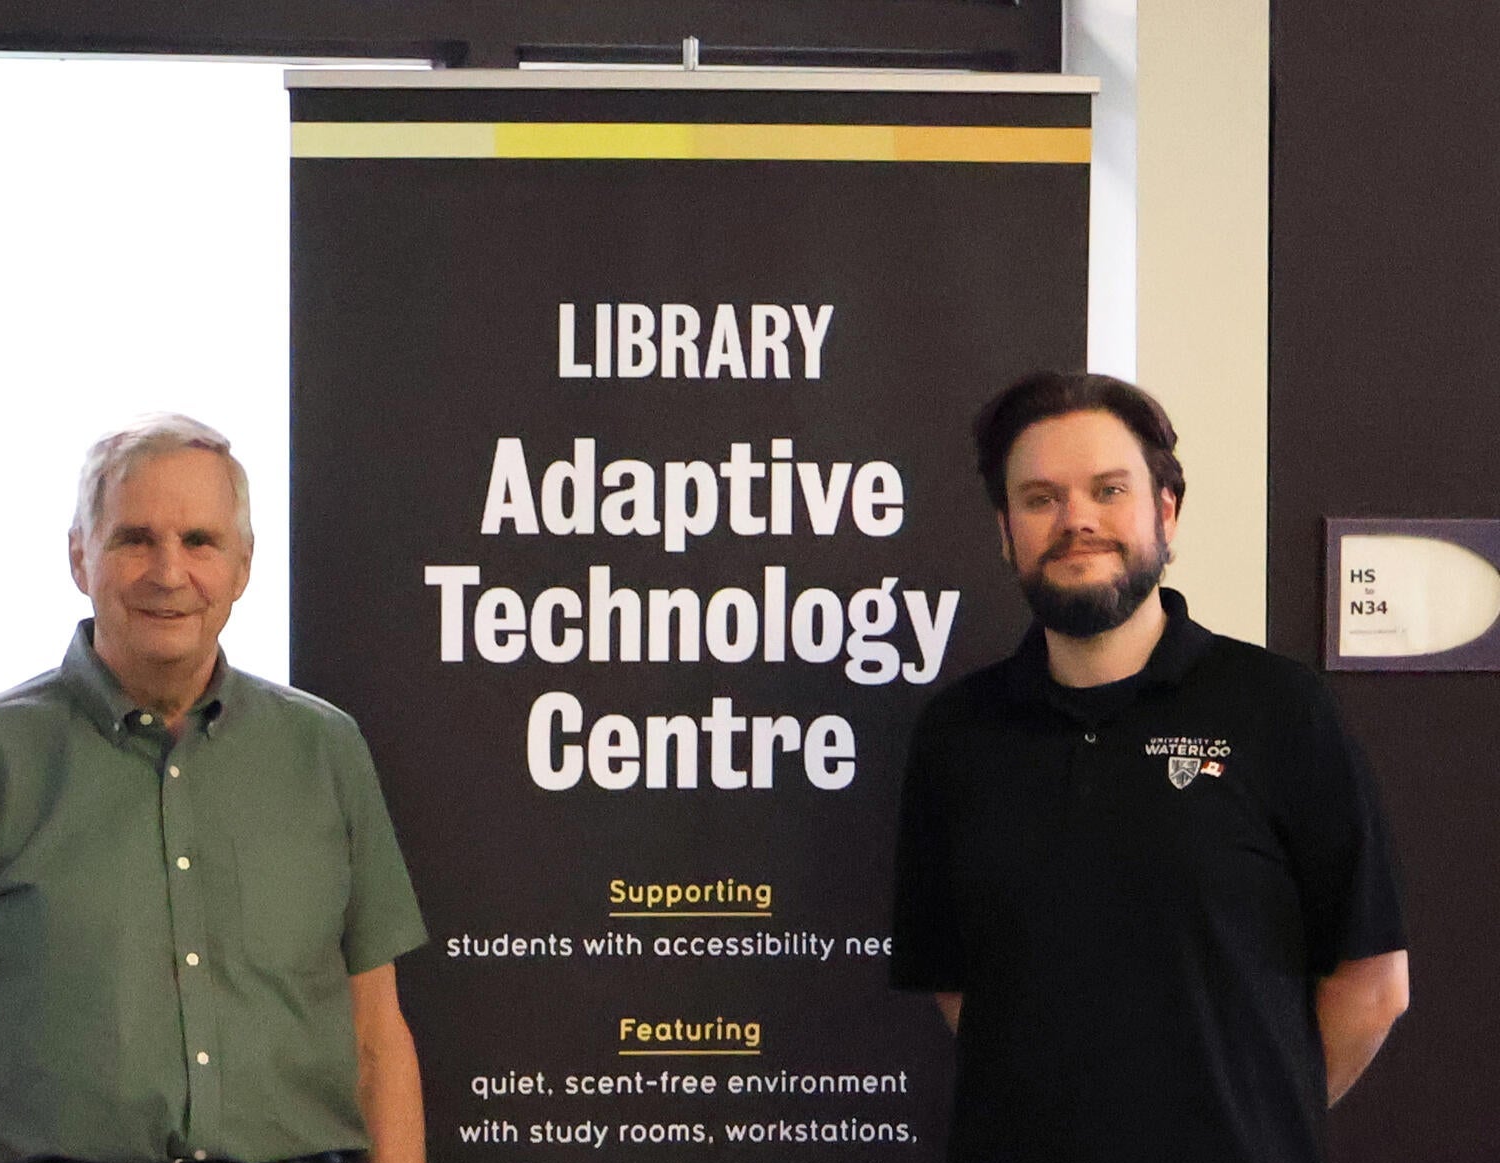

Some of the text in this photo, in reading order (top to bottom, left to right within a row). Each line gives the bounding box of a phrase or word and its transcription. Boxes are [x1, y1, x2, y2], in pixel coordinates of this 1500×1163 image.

[558, 303, 835, 380] LIBRARY
[480, 437, 904, 553] Adaptive
[1350, 568, 1376, 583] HS
[1350, 600, 1388, 615] N34
[424, 565, 961, 686] Technology
[526, 691, 857, 792] Centre
[1144, 743, 1231, 757] WATERLOO
[609, 878, 772, 908] Supporting
[446, 931, 892, 961] students with accessibility nee
[620, 1016, 761, 1047] Featuring
[471, 1069, 907, 1100] quiet, scent-free environment
[459, 1117, 918, 1149] with study rooms, workstations,
